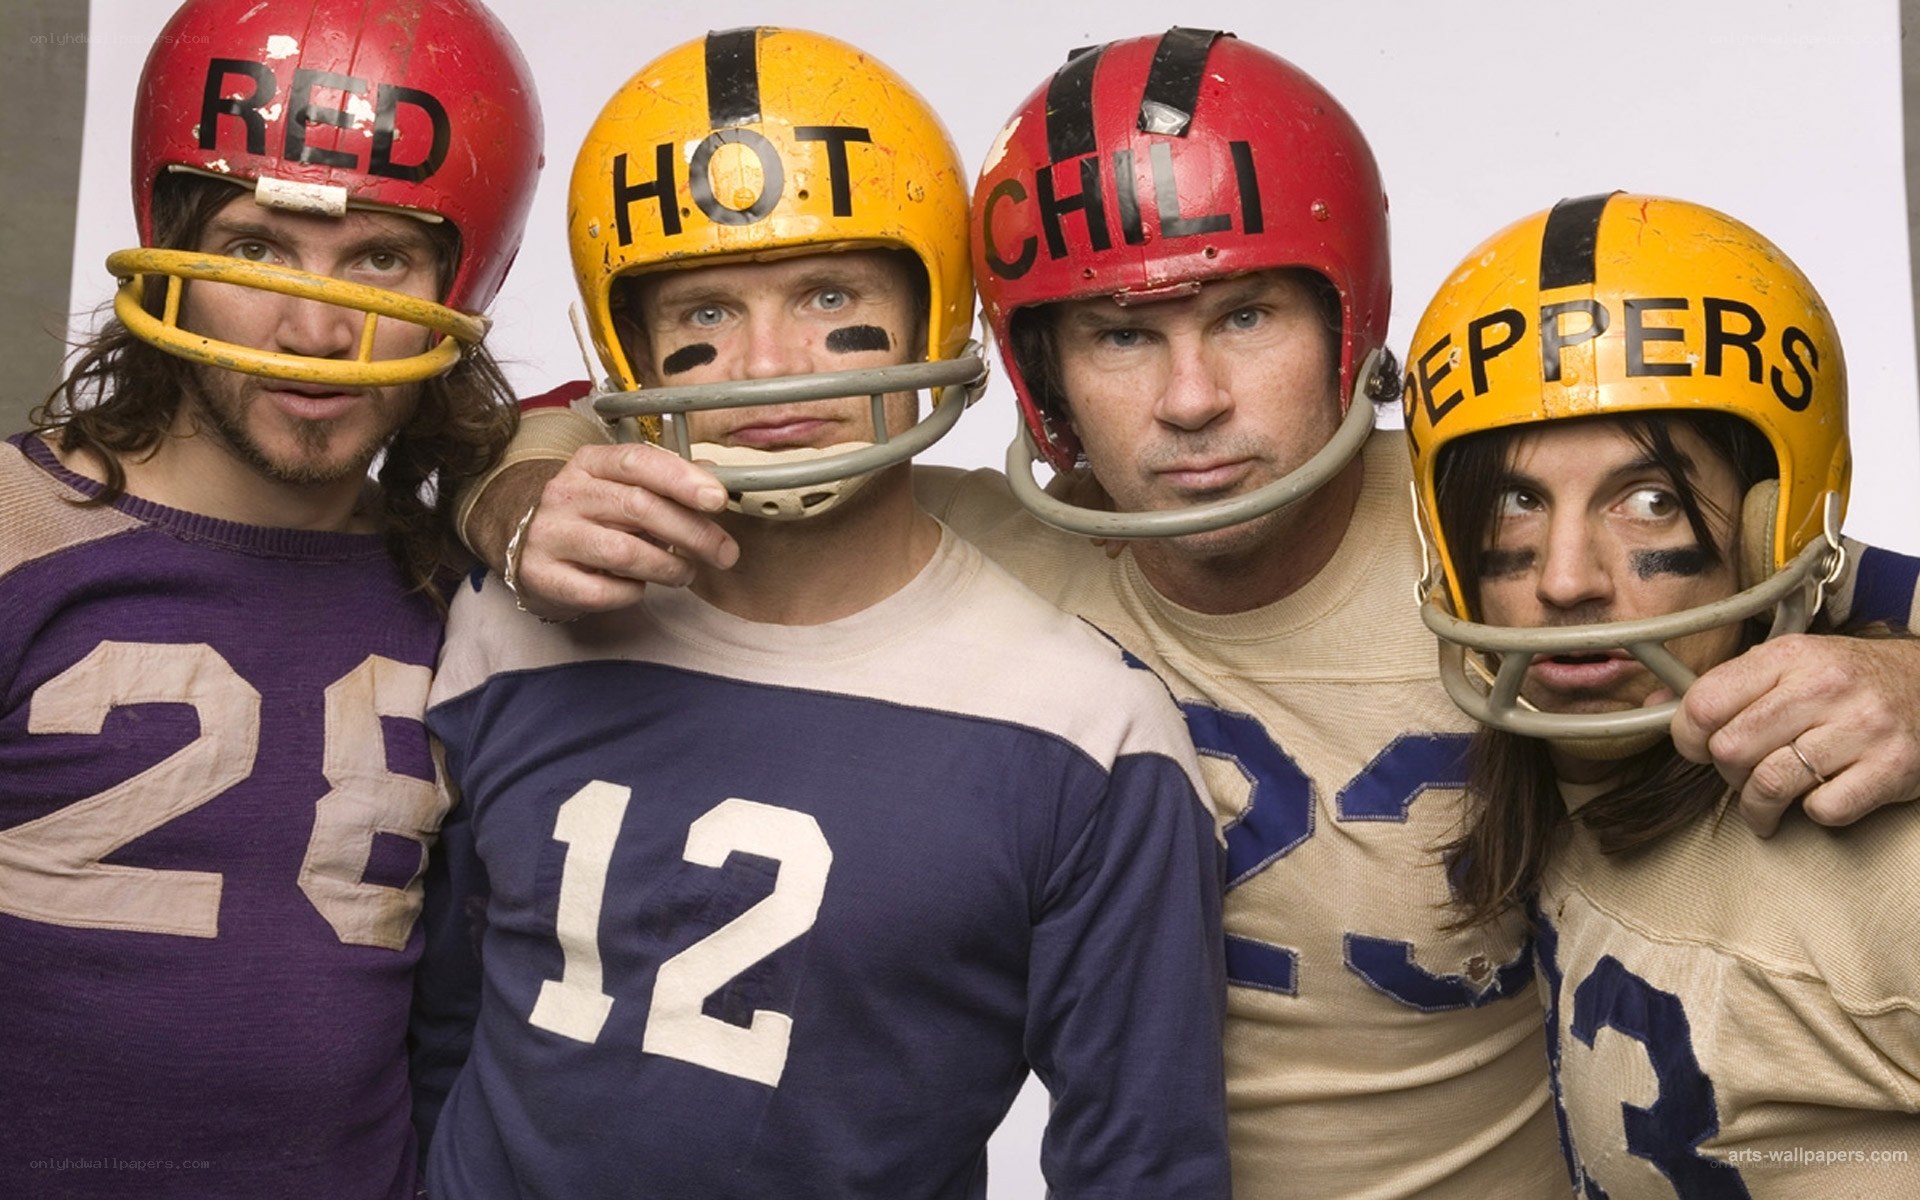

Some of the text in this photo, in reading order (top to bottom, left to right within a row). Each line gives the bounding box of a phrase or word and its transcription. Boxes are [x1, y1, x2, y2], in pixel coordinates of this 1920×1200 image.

[199, 58, 452, 183] RED
[613, 126, 872, 247] HOT
[983, 140, 1264, 280] CHILI
[1403, 297, 1819, 458] PEPPERS
[528, 779, 833, 1087] 12
